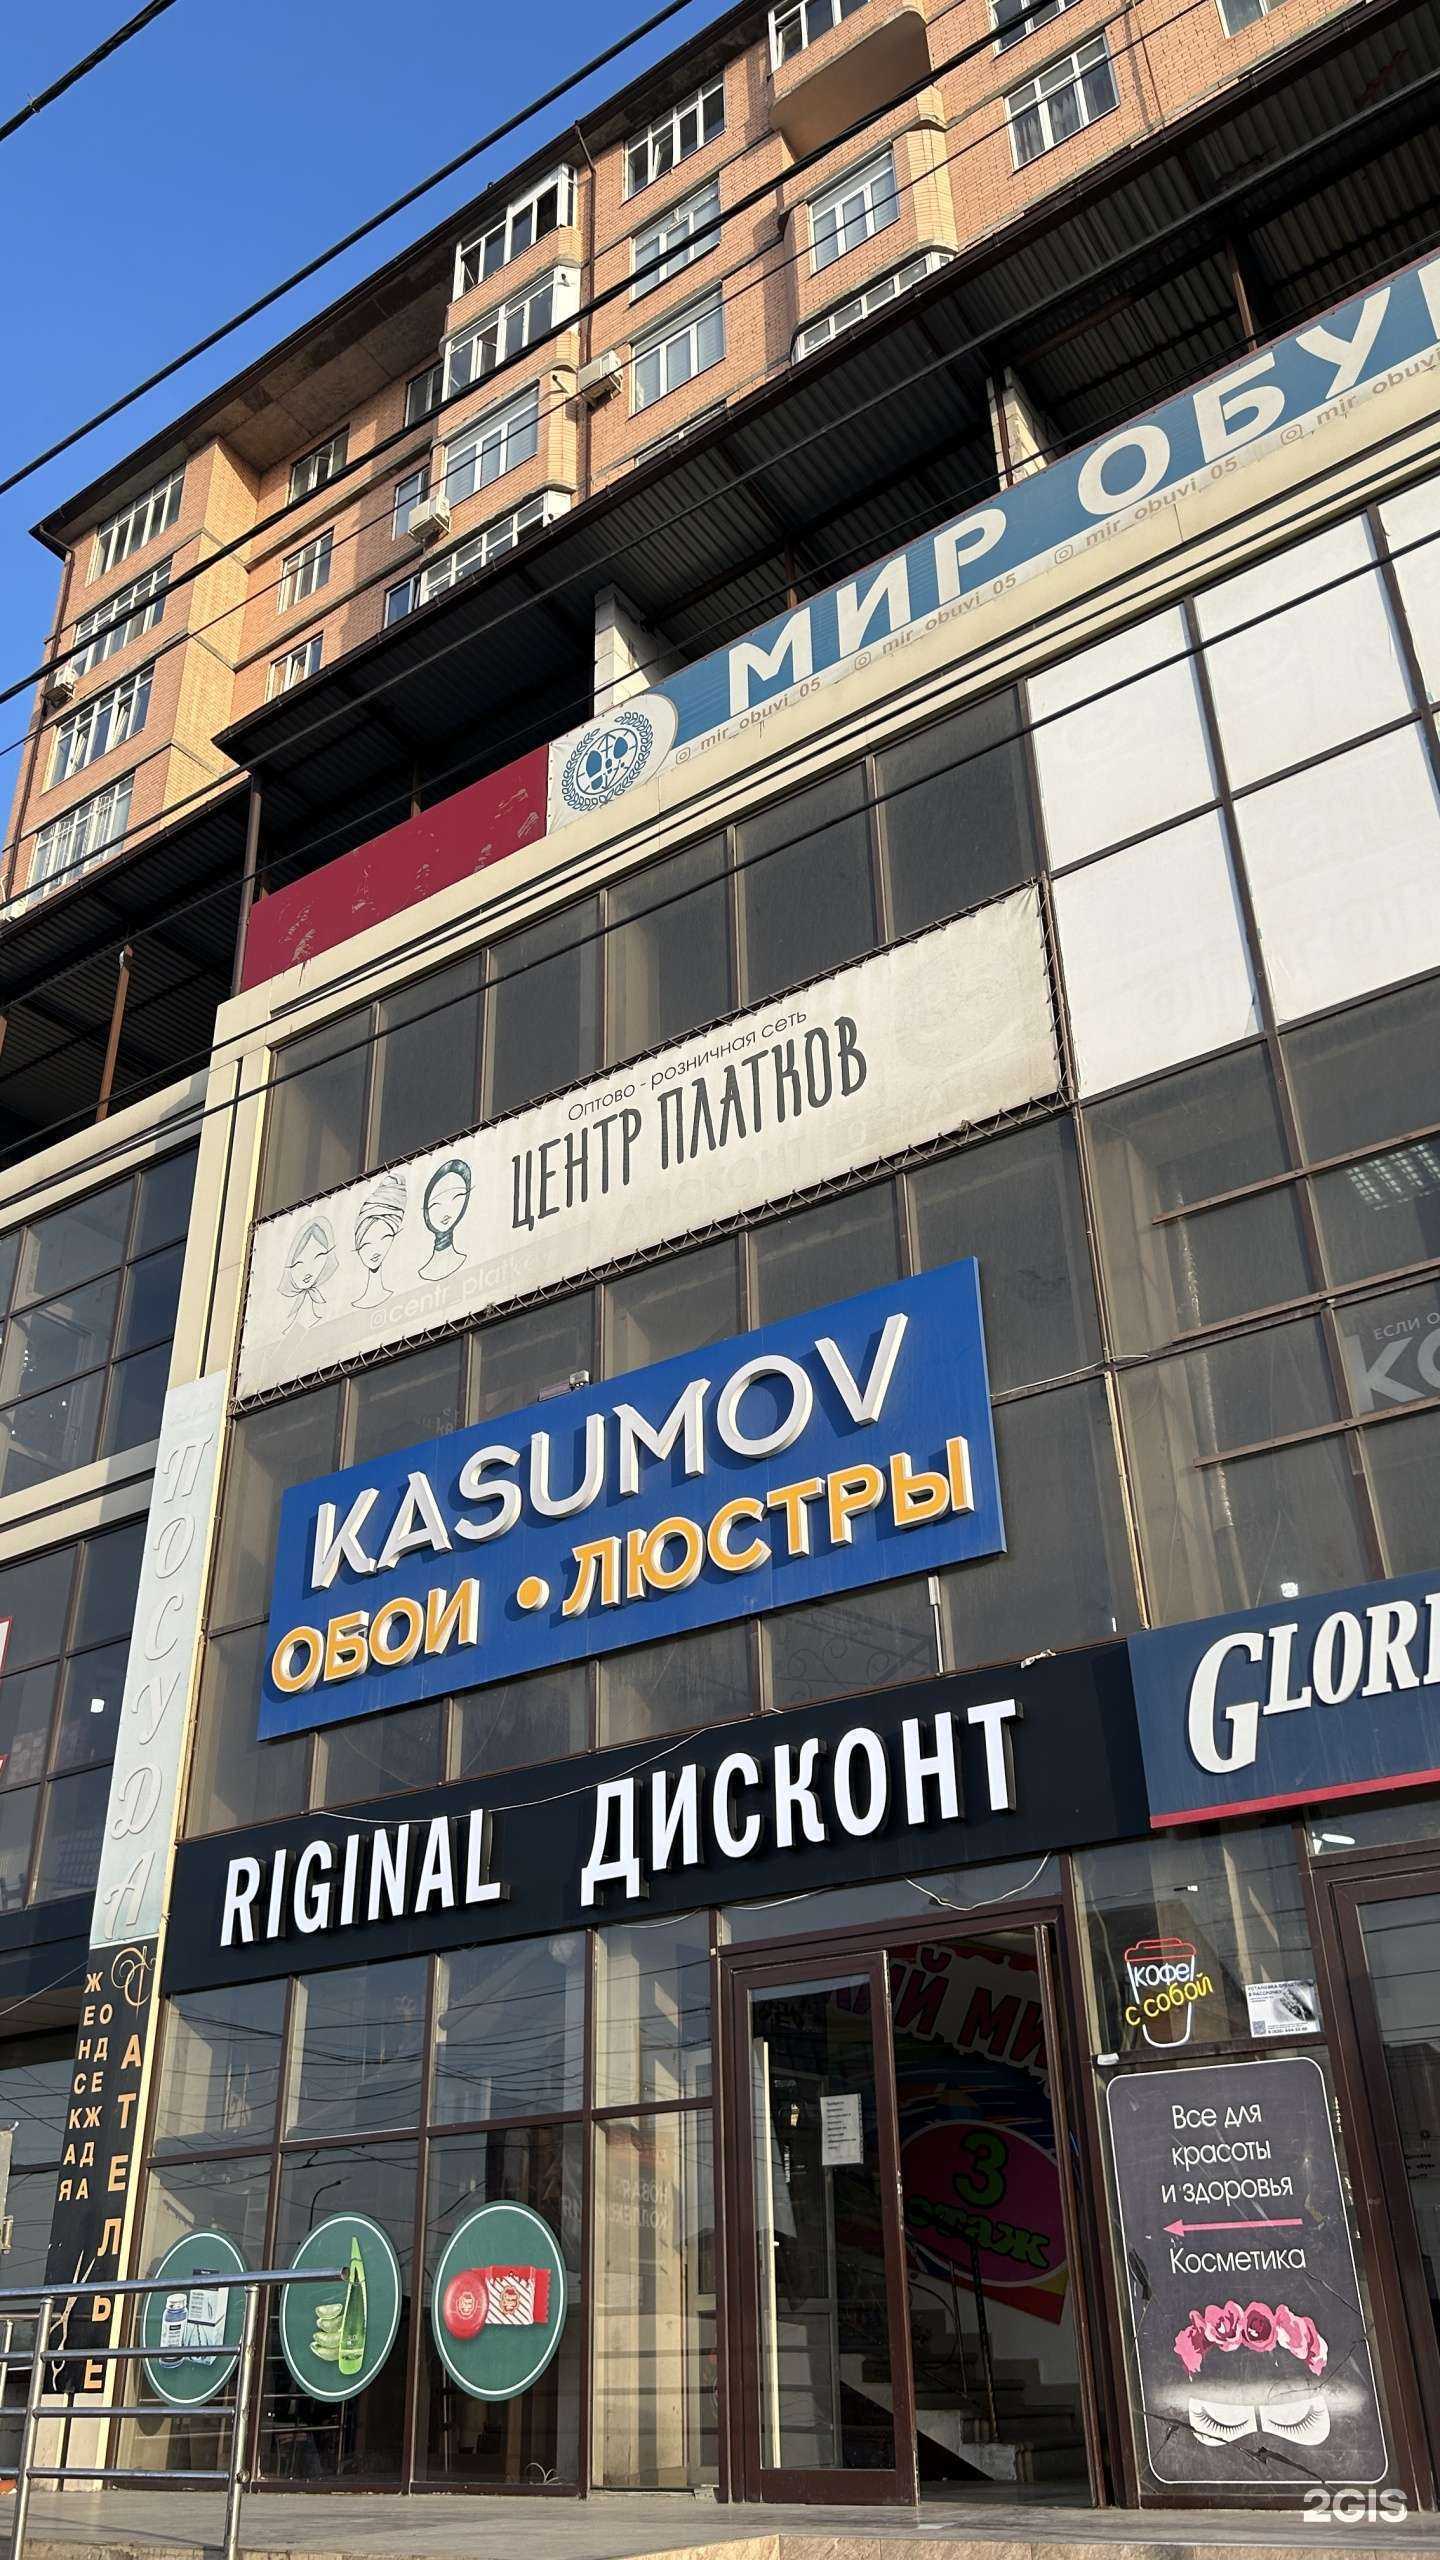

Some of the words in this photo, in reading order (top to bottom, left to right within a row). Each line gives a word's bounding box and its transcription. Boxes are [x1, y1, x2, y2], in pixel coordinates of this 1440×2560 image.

[1086, 456, 1208, 547] mir_obuvi_05
[729, 508, 1006, 717] МИР
[882, 572, 1017, 655] mir_obuvi_05
[700, 676, 821, 750] mir_obuvi_05
[568, 1084, 635, 1121] Оптово
[651, 1031, 756, 1090] розничная
[761, 1010, 807, 1038] сеть
[511, 1107, 643, 1232] ЦЕНТР
[658, 1016, 867, 1170] ПЛАТКОВ
[1374, 1317, 1420, 1341] ЕСЛИ
[311, 1313, 908, 1590] KASUMOV
[271, 1577, 481, 1694] ОБОИ
[562, 1436, 975, 1618] ЛЮСТРЫ
[220, 1808, 509, 1947] RIGINAL
[581, 1699, 1020, 1907] ДИСКОНТ
[1144, 1972, 1213, 2017] собой
[1172, 2105, 1217, 2130] Все
[1223, 2104, 1262, 2129] для
[1172, 2138, 1271, 2172] красоты
[953, 2129, 1008, 2208] 3
[1162, 2185, 1177, 2203] и
[1183, 2176, 1293, 2207] здоровья
[1170, 2246, 1307, 2274] Косметика
